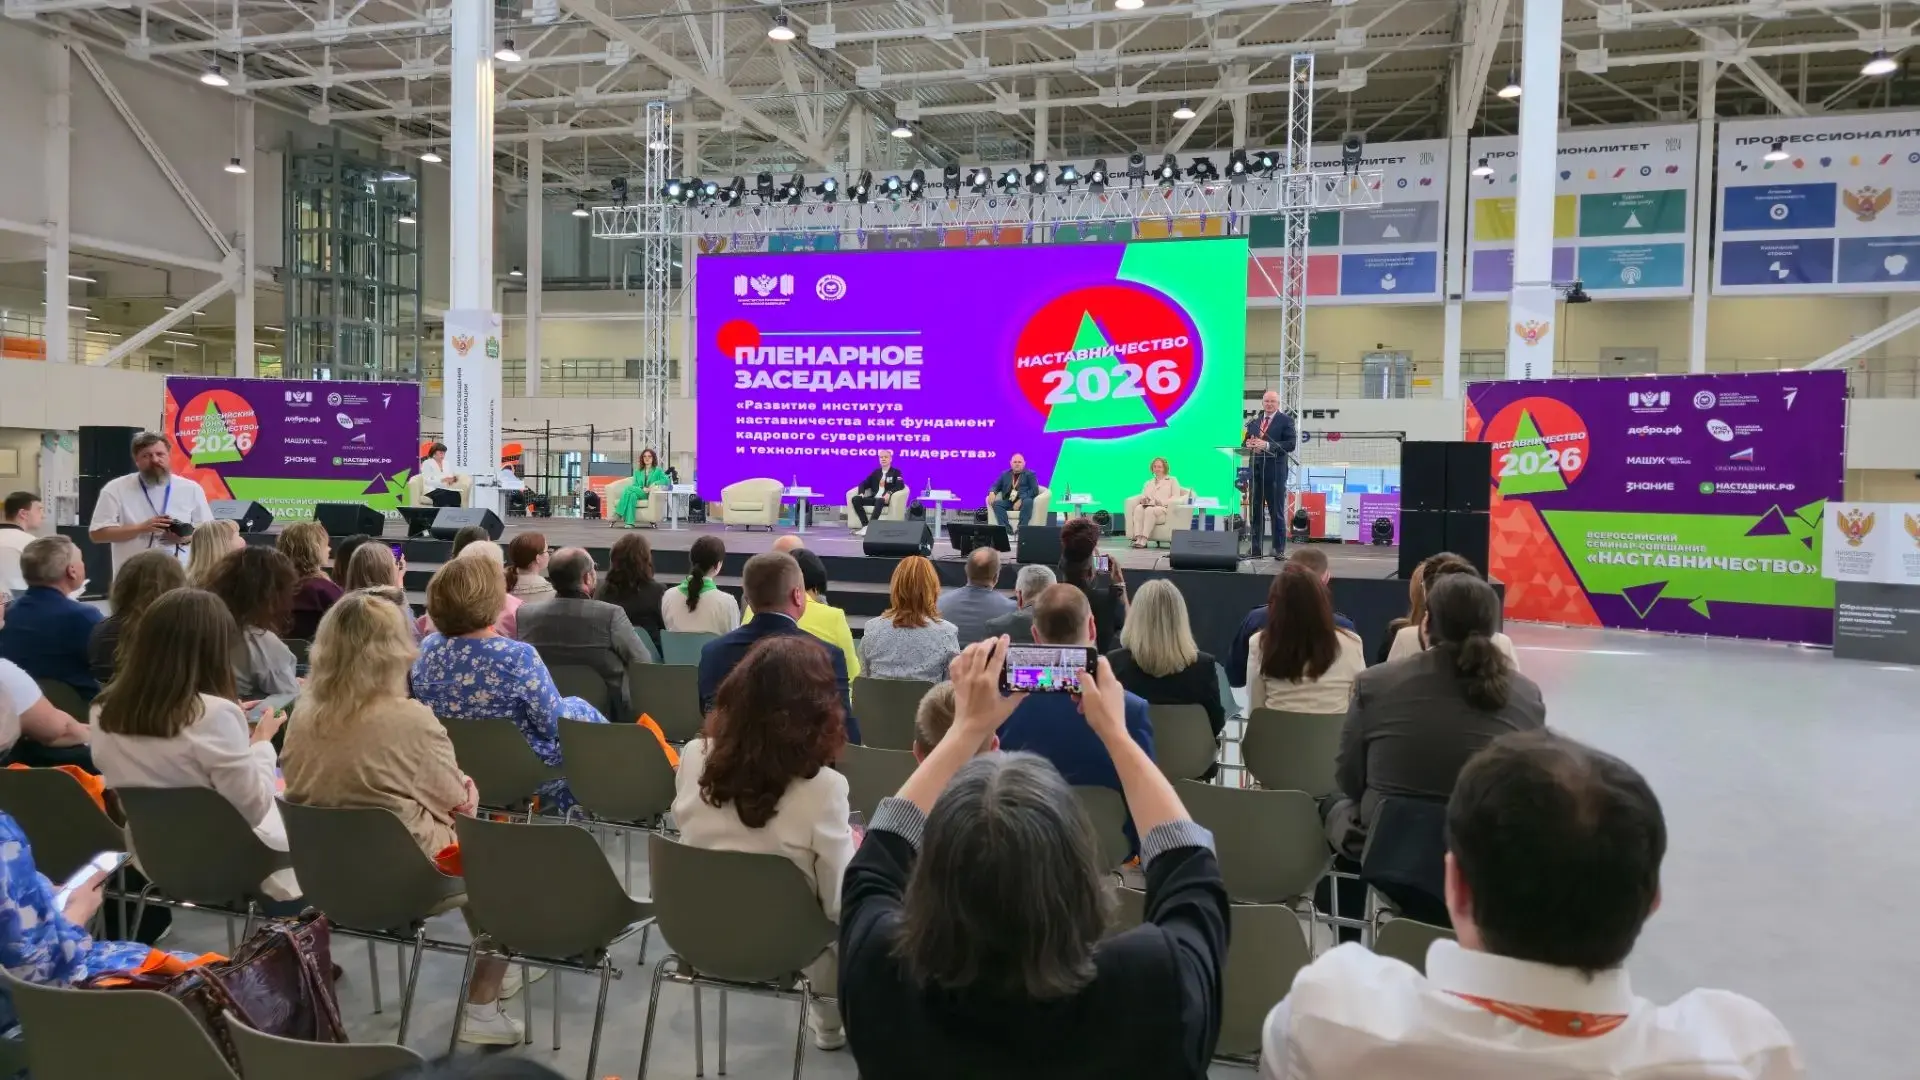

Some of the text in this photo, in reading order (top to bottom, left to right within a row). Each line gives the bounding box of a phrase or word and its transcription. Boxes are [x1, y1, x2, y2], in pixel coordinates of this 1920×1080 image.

[1486, 143, 1650, 159] ПРОИОНАЛИТЕТ
[734, 346, 923, 365] ПЛЕНАРНОЕ
[1017, 336, 1189, 368] НАСТАВНИЧЕСТВО
[734, 370, 921, 392] ЗАСЕДАНИЕ
[1042, 359, 1181, 405] 2026
[736, 400, 903, 414] «Развитие института
[736, 415, 996, 429] наставничества как фундамент
[736, 430, 931, 443] кадрового суверенитета
[1627, 425, 1682, 436] добро.рф
[190, 432, 252, 454] 2026
[1491, 432, 1586, 450] АСТАВНИЧЕСТВО
[736, 446, 745, 454] и
[899, 448, 997, 459] лидерства»
[1626, 456, 1666, 464] МАШУК
[1498, 447, 1581, 476] 2026
[1715, 482, 1795, 491] НАСТАВНИК.РФ
[1586, 531, 1678, 542] ВСЕРОССИЙСКИЙ
[1586, 551, 1818, 575] «НАСТАВНИЧЕСТВО»
